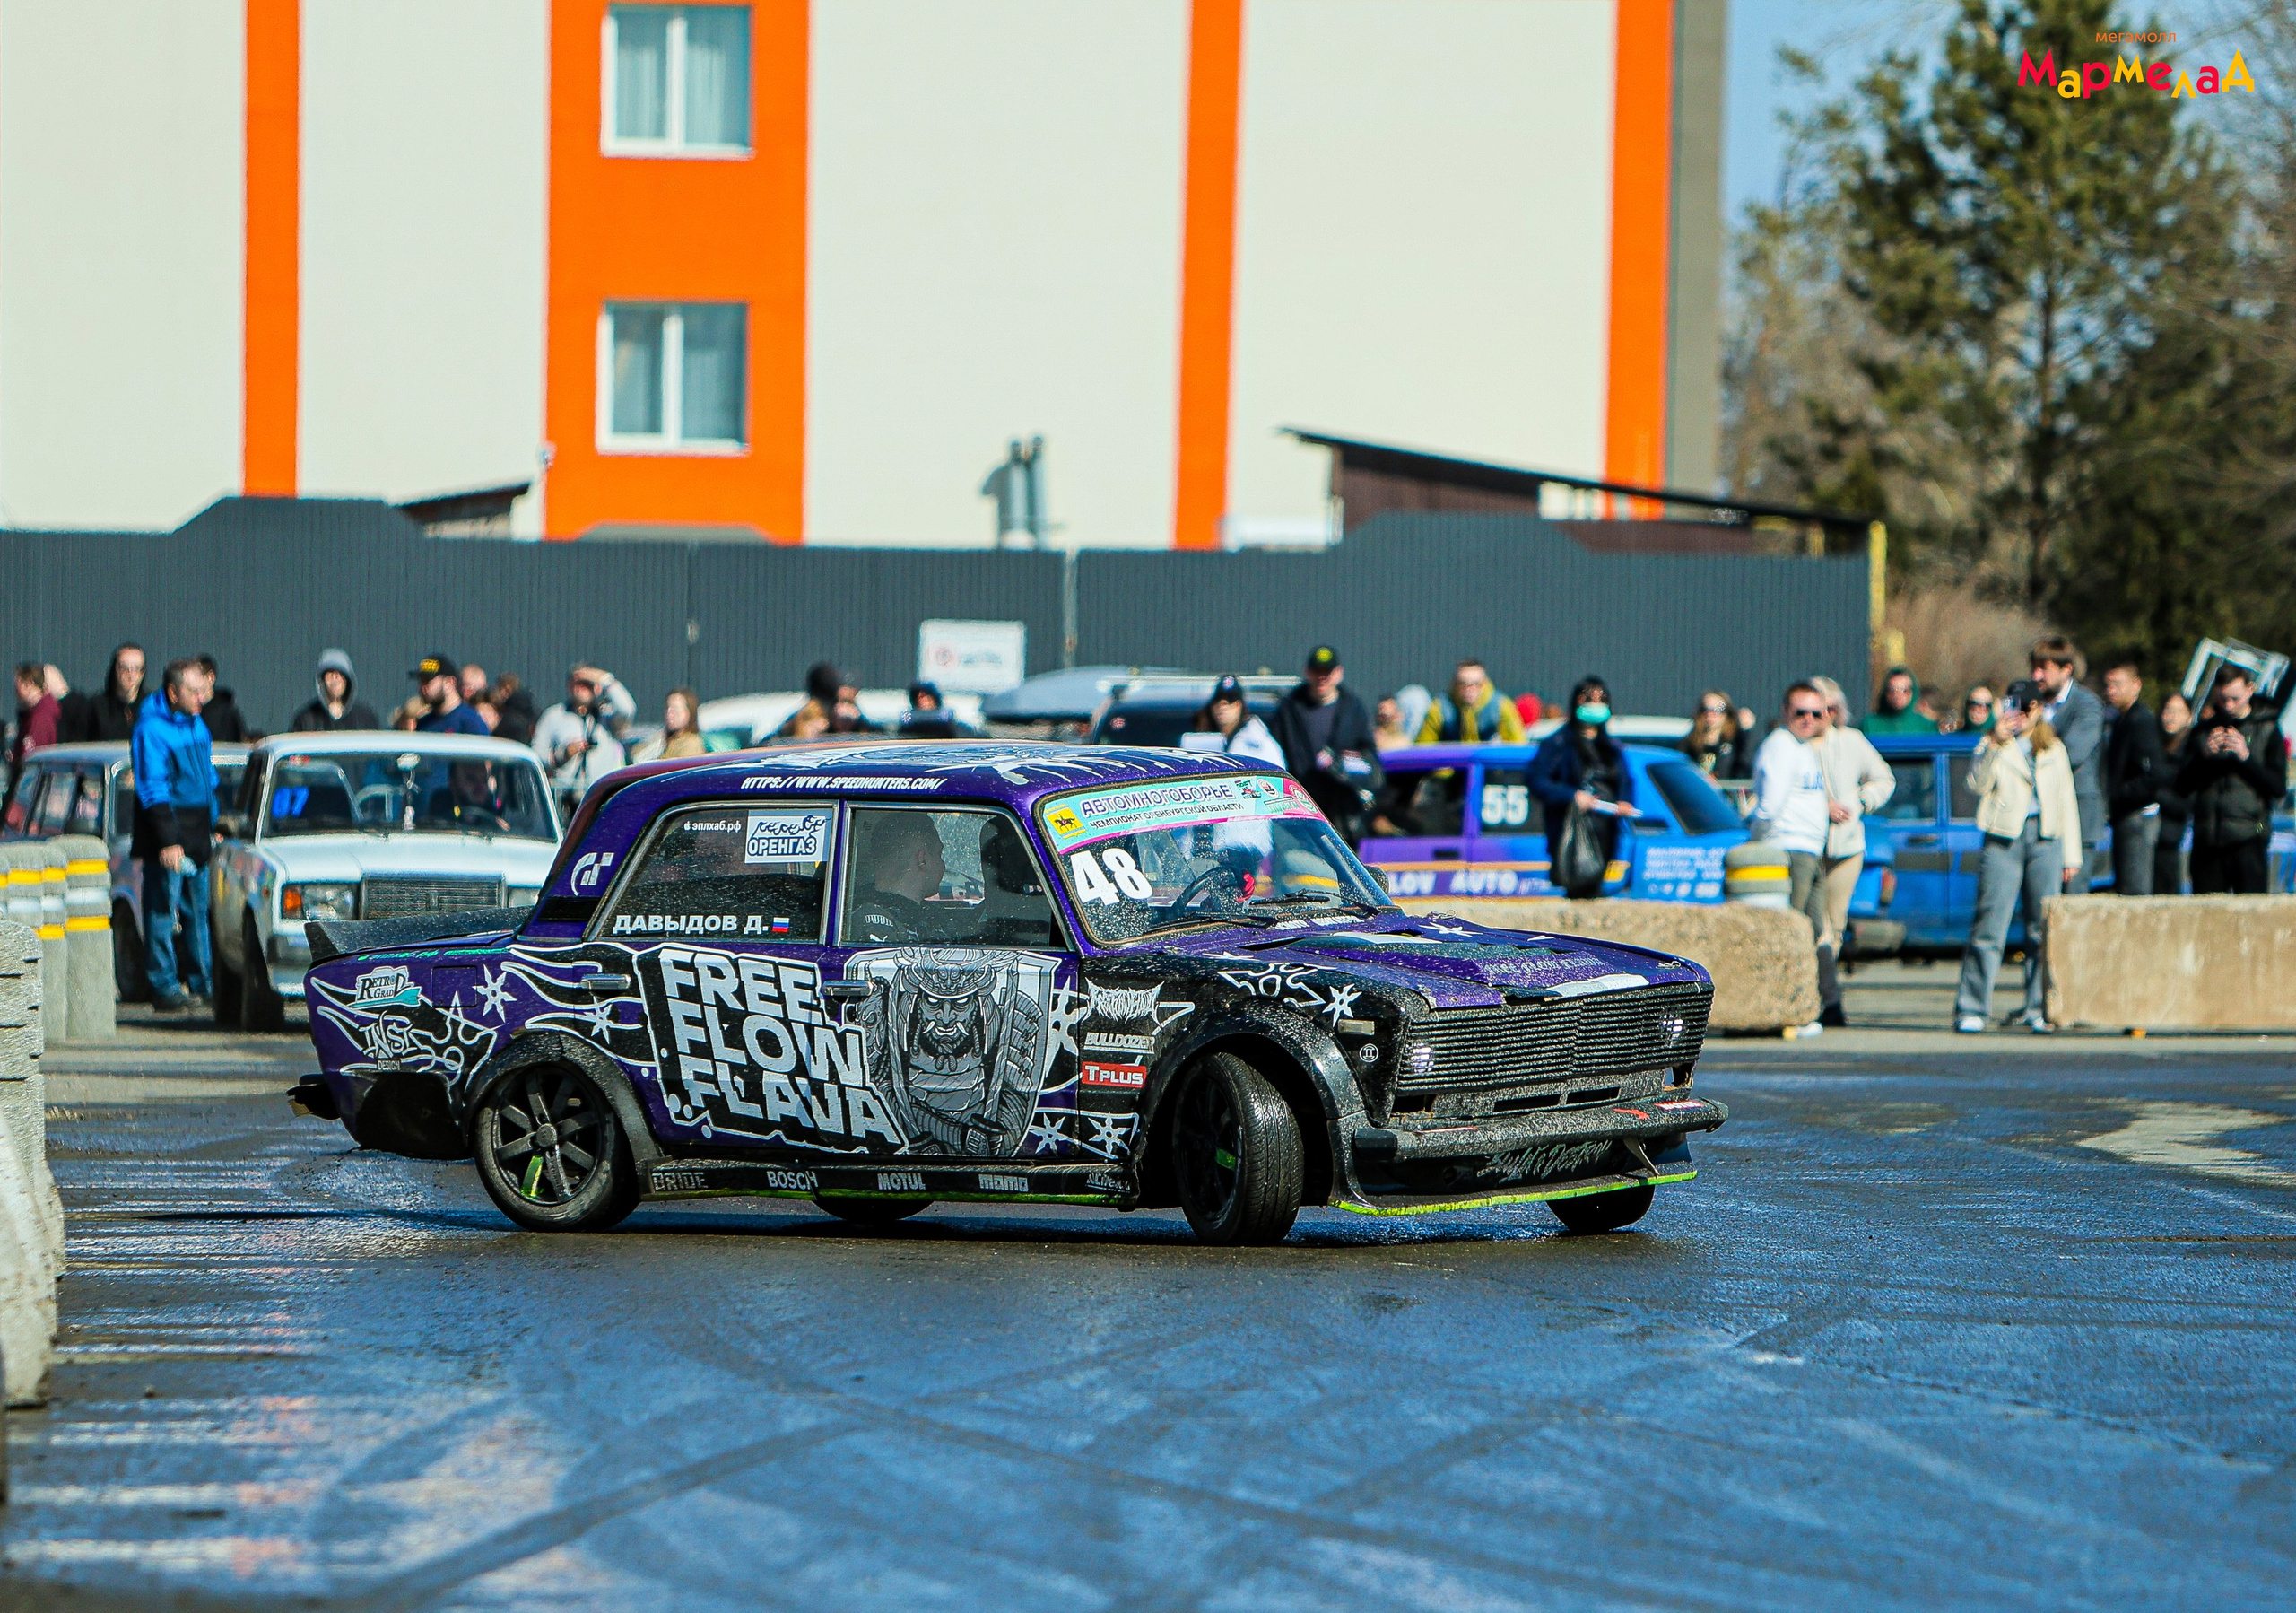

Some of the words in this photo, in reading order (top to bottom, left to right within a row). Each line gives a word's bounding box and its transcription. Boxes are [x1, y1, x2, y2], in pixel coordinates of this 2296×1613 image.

[741, 777, 947, 789] HTTPS://WWW.SPEEDHUNTERS.COM/
[1079, 783, 1234, 817] АВТОМНОГОБОРЬЕ
[1481, 784, 1529, 825] 55
[692, 820, 742, 833] эплхаб.рф
[1089, 812, 1144, 830] ЧЕМПИОНАТ
[1144, 804, 1207, 822] ОРЕНБУРГСКОЙ
[1207, 802, 1244, 814] ОБЛАСТИ
[747, 837, 817, 856] ОРЕНГАЗ
[1070, 848, 1153, 907] 48
[1449, 869, 1519, 895] AUTO
[613, 915, 737, 935] ДАВЫДОВ
[744, 915, 769, 935] Д.
[658, 948, 822, 1025] FREE
[667, 998, 863, 1086] FLOW
[1084, 1032, 1155, 1053] BULLDOZER
[678, 1054, 902, 1145] FLAVA
[652, 1172, 709, 1191] BRIDE
[766, 1170, 819, 1190] BOSCH
[877, 1173, 926, 1190] MOTUL
